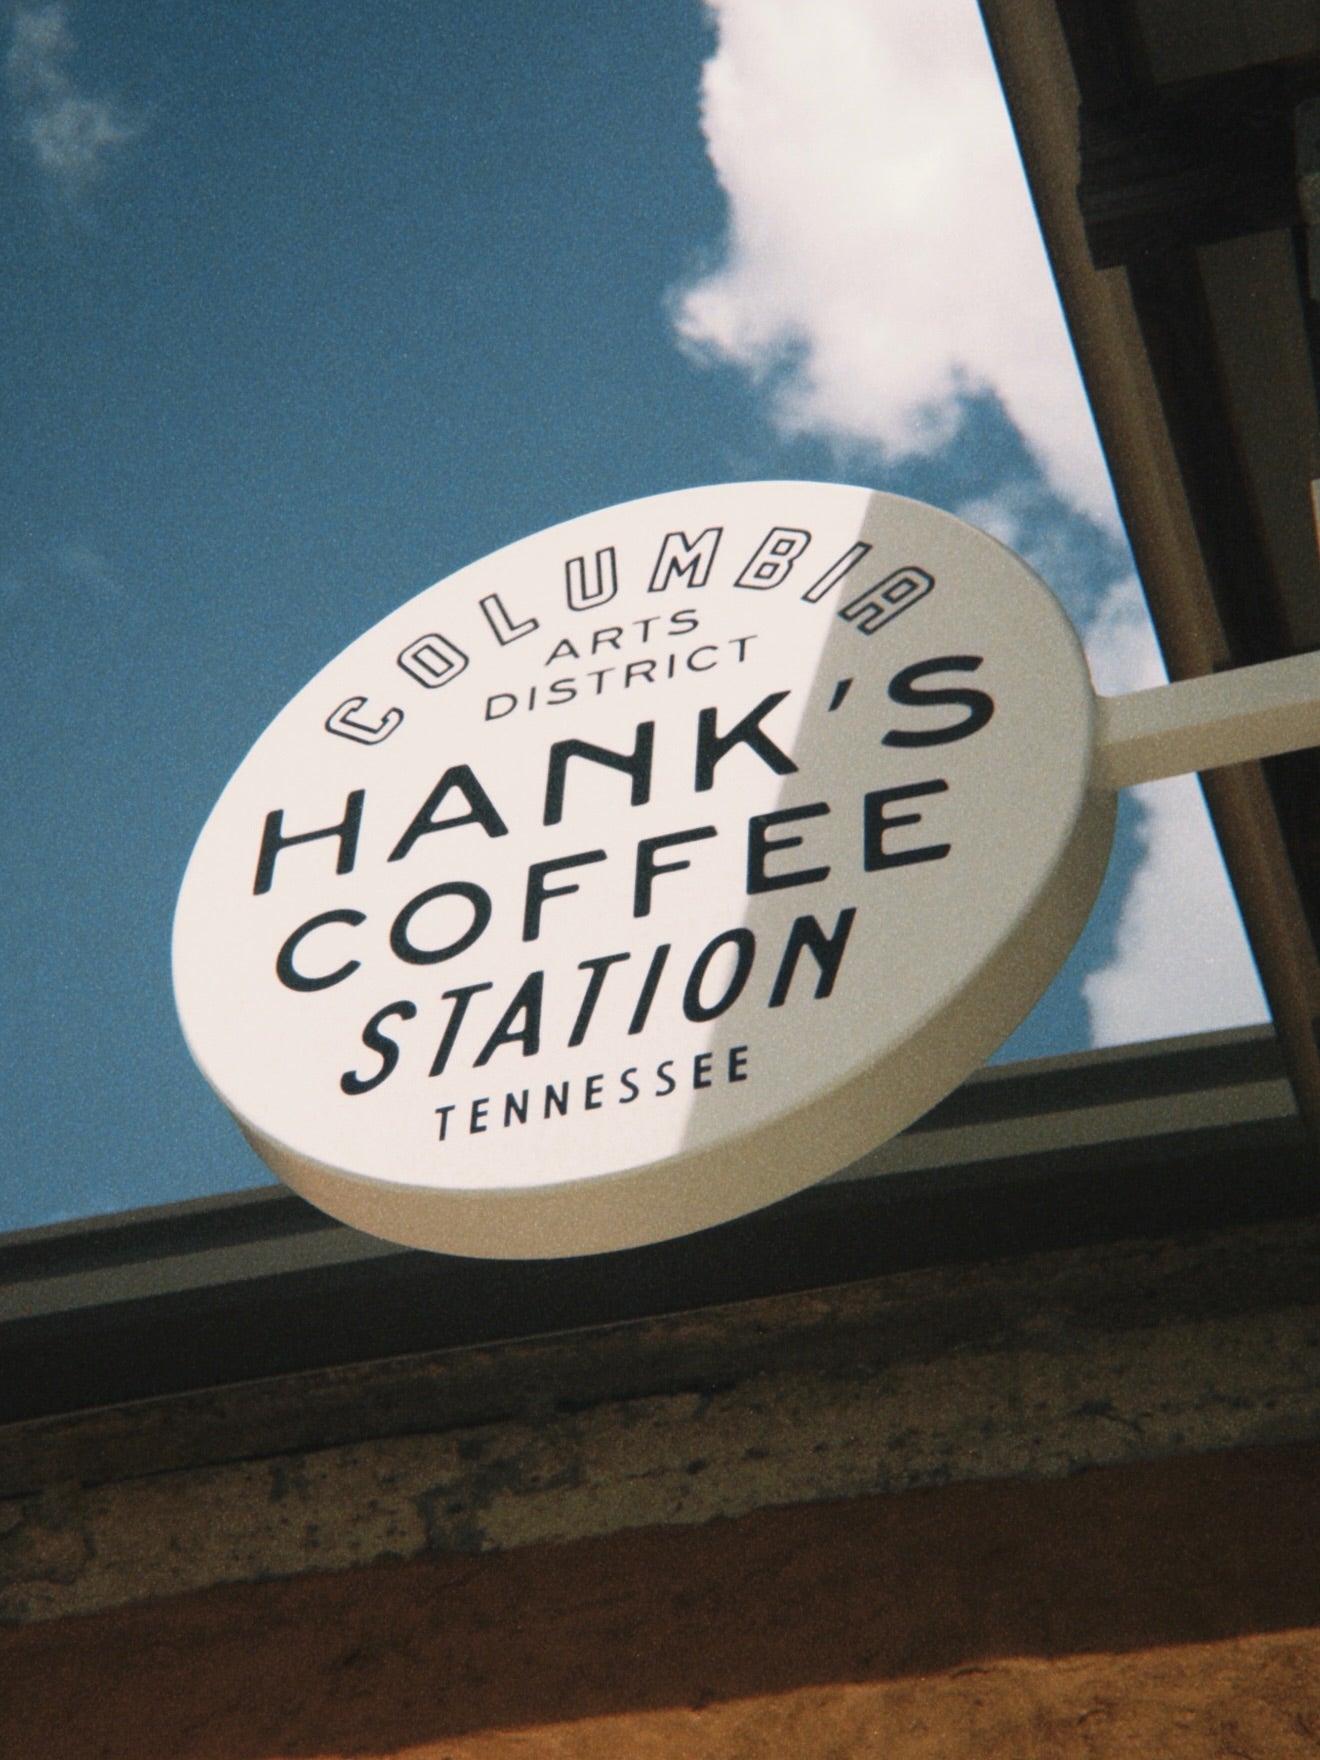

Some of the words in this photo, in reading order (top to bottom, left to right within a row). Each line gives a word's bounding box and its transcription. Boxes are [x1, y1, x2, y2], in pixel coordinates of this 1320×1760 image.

[325, 526, 936, 746] COLUMBIA
[485, 636, 758, 721] DISTRICT
[545, 608, 700, 666] ARTS
[252, 655, 995, 896] HANK'S
[275, 778, 951, 993] COFFEE
[340, 907, 857, 1096] STATION
[435, 1045, 749, 1142] TENNESSEE
